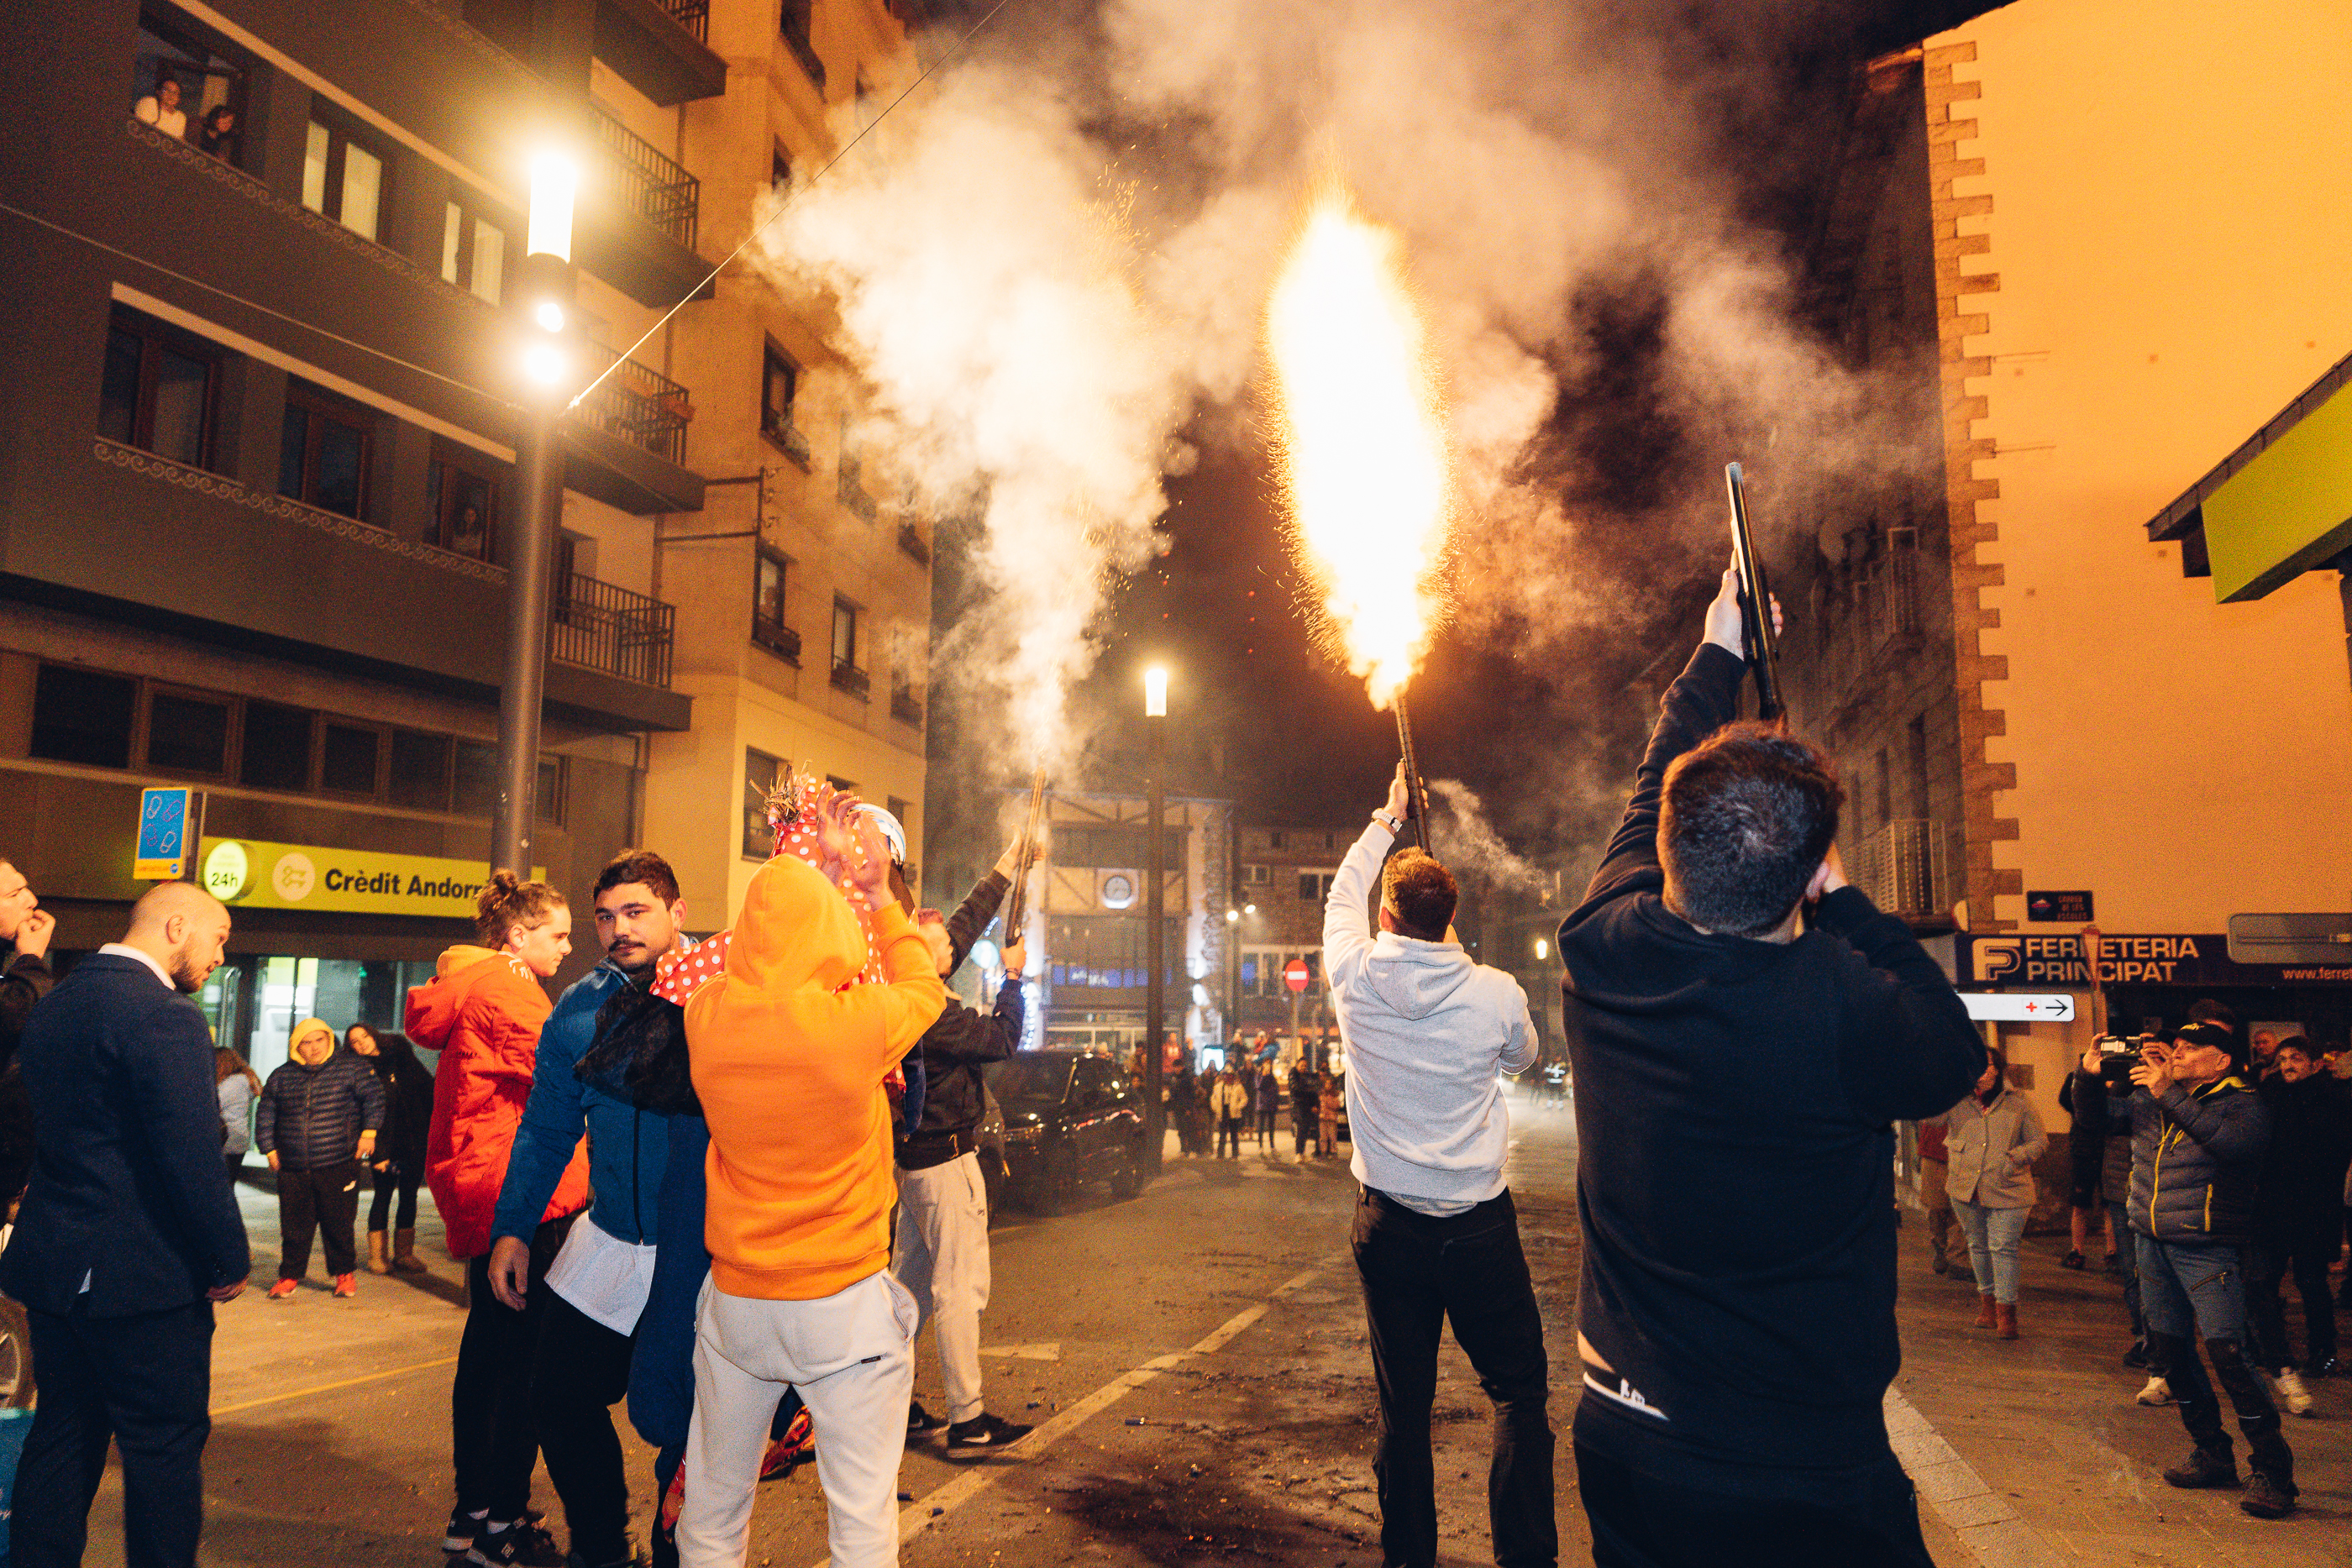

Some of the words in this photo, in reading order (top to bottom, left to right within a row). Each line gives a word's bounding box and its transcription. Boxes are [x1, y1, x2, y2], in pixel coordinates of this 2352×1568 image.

[212, 872, 239, 887] 24h
[325, 868, 401, 894] Crèdit
[407, 874, 487, 899] Andorr
[2027, 961, 2177, 981] PRINCIPAT
